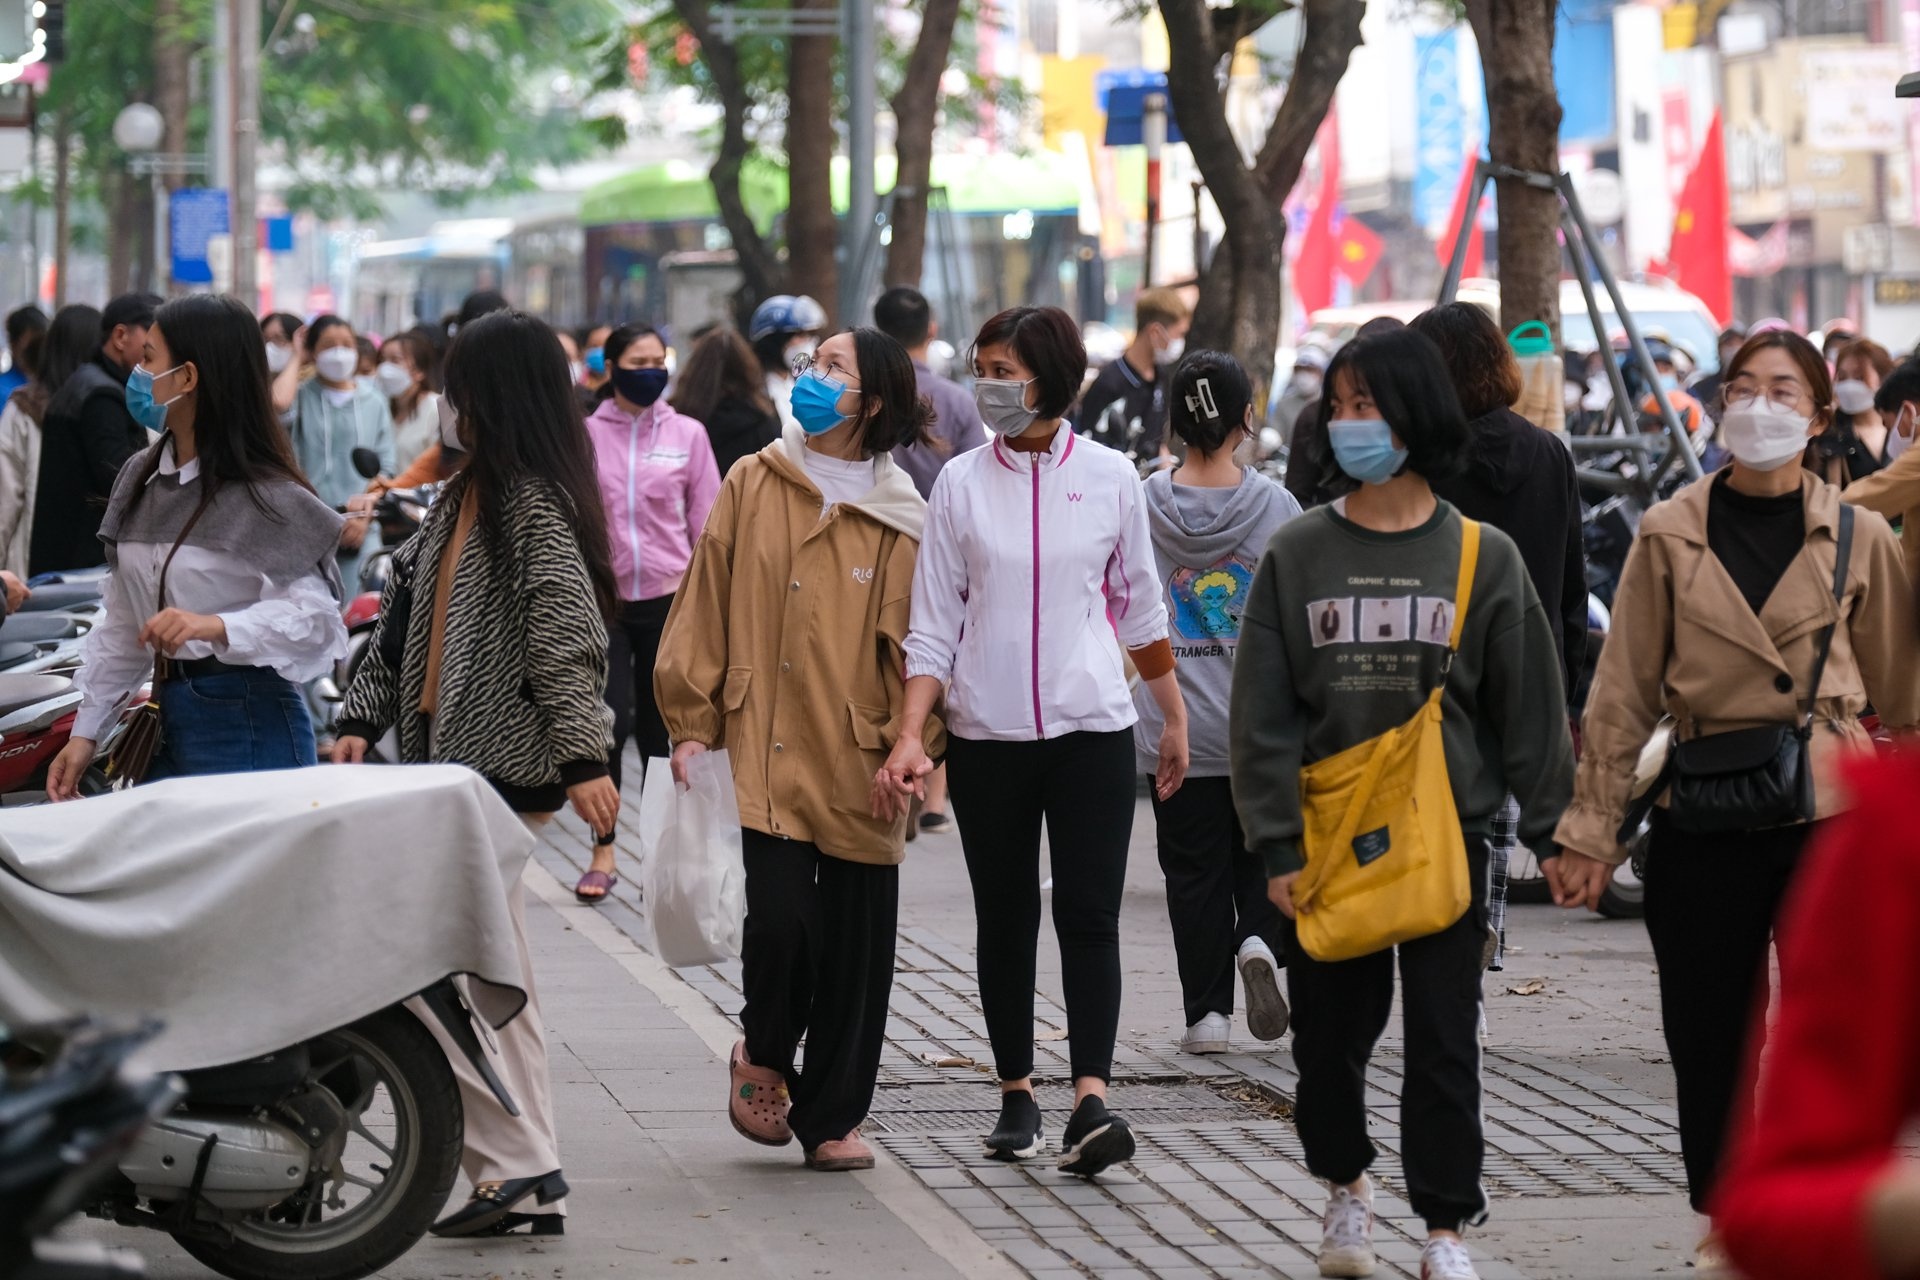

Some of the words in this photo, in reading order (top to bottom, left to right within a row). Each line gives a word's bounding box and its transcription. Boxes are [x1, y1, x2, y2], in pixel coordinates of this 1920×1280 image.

[1347, 576, 1385, 586] GRAPHIC
[1171, 645, 1224, 658] TRANGER
[1353, 654, 1373, 662] OCT
